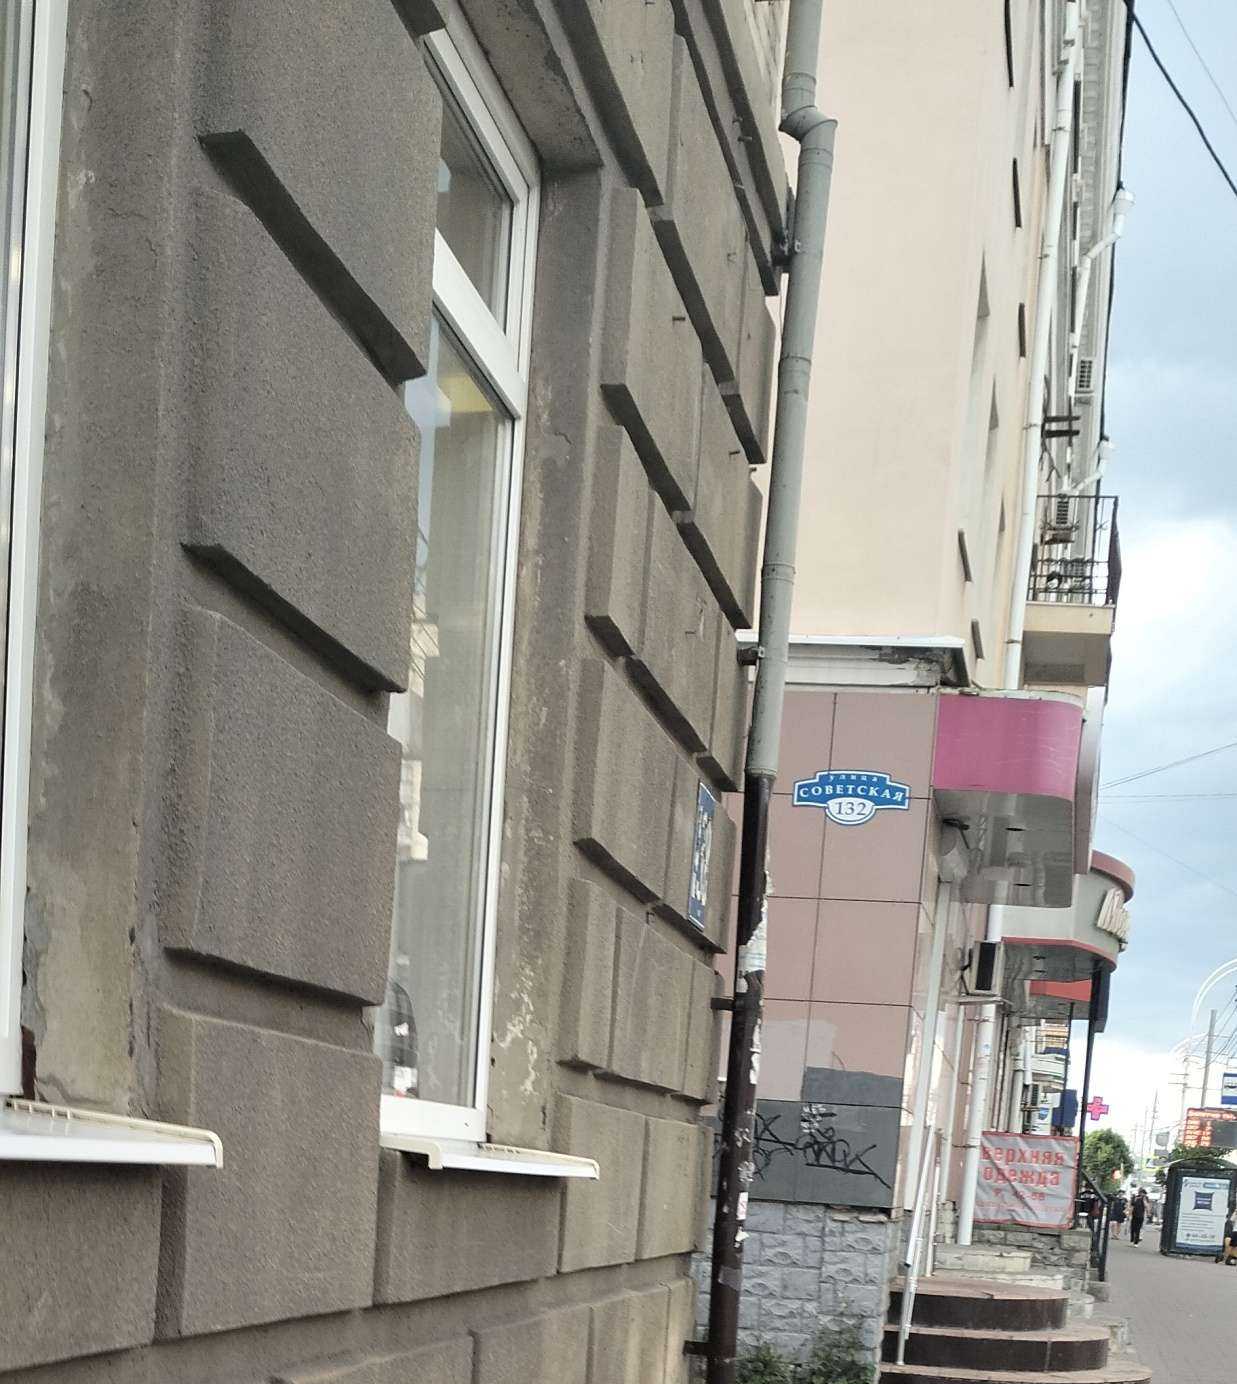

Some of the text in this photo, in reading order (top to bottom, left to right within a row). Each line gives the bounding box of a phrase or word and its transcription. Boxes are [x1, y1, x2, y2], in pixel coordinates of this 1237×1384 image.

[829, 774, 879, 782] улица
[799, 784, 905, 802] СОВЕТСКАЯ
[835, 801, 867, 816] 132
